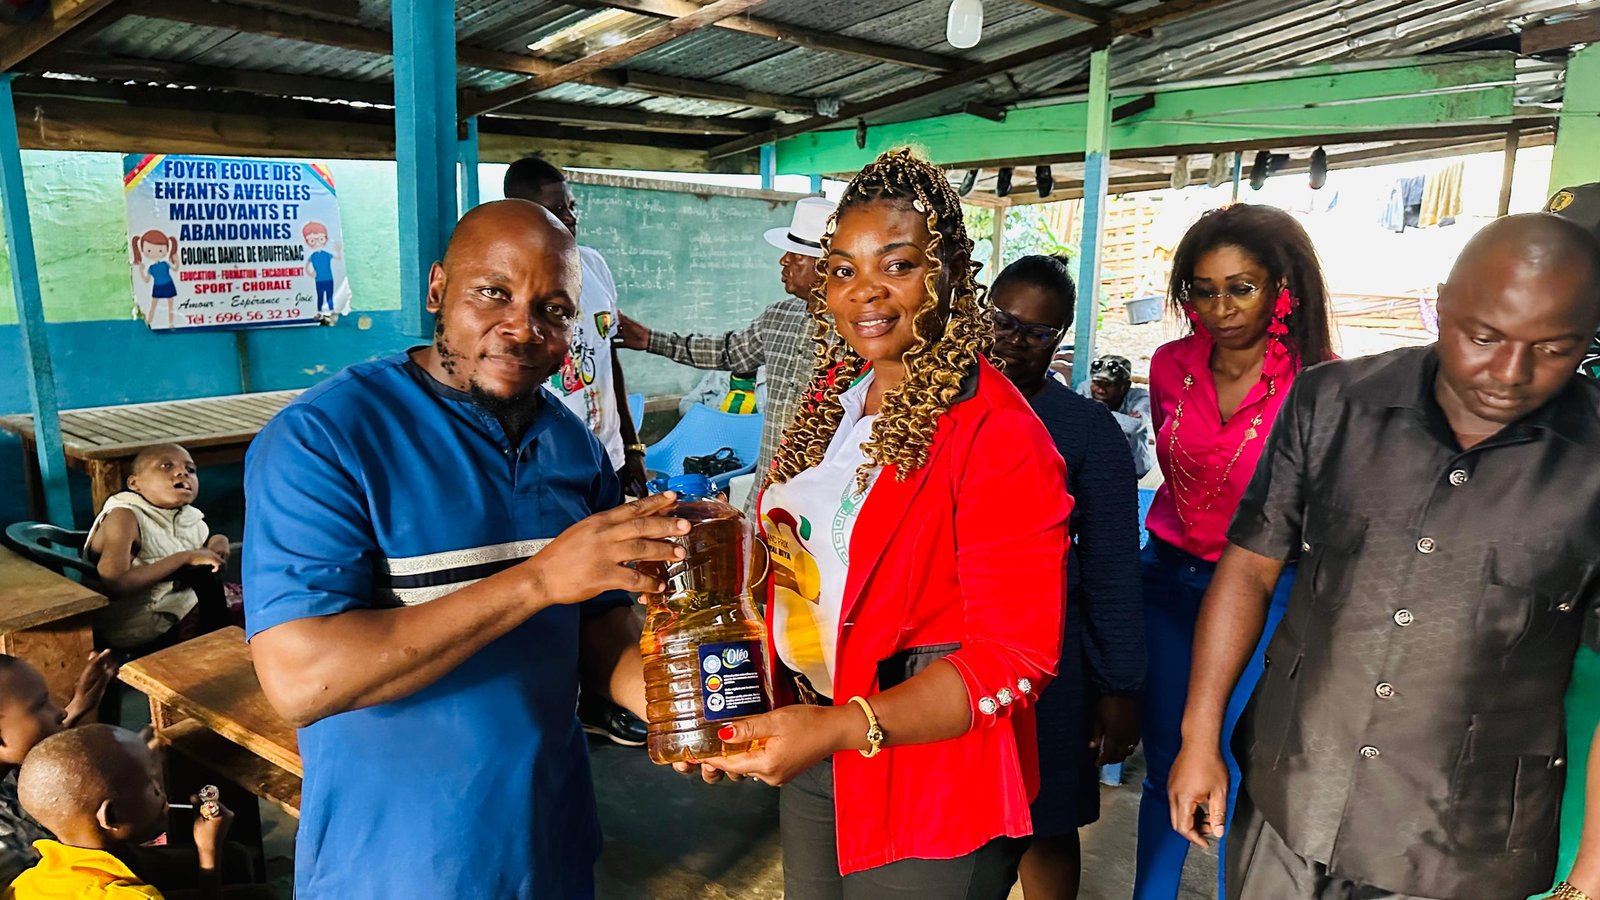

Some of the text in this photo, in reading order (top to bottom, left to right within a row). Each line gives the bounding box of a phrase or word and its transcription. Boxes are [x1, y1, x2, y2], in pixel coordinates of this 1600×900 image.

[164, 160, 302, 181] FOYER ECOLE DES
[154, 182, 310, 200] ENFANTS AVEUGLES
[170, 203, 299, 220] MALVOYANTS ET
[180, 223, 291, 241] ABANDONNES
[181, 246, 216, 266] COLONEL
[218, 246, 246, 264] DANIEL
[247, 246, 256, 262] DE
[180, 270, 216, 281] EDUCATION
[222, 269, 257, 280] FORMATION
[262, 267, 304, 278] ENCADREMENT
[194, 282, 233, 294] SPORT
[242, 280, 292, 292] CHORALE
[178, 298, 214, 310] Amour
[231, 295, 280, 308] Espérance
[295, 293, 312, 306] Joie
[216, 312, 242, 323] 696
[247, 311, 263, 320] 56
[267, 309, 282, 319] 32
[286, 308, 300, 318] 19
[726, 648, 749, 664] Oléo
